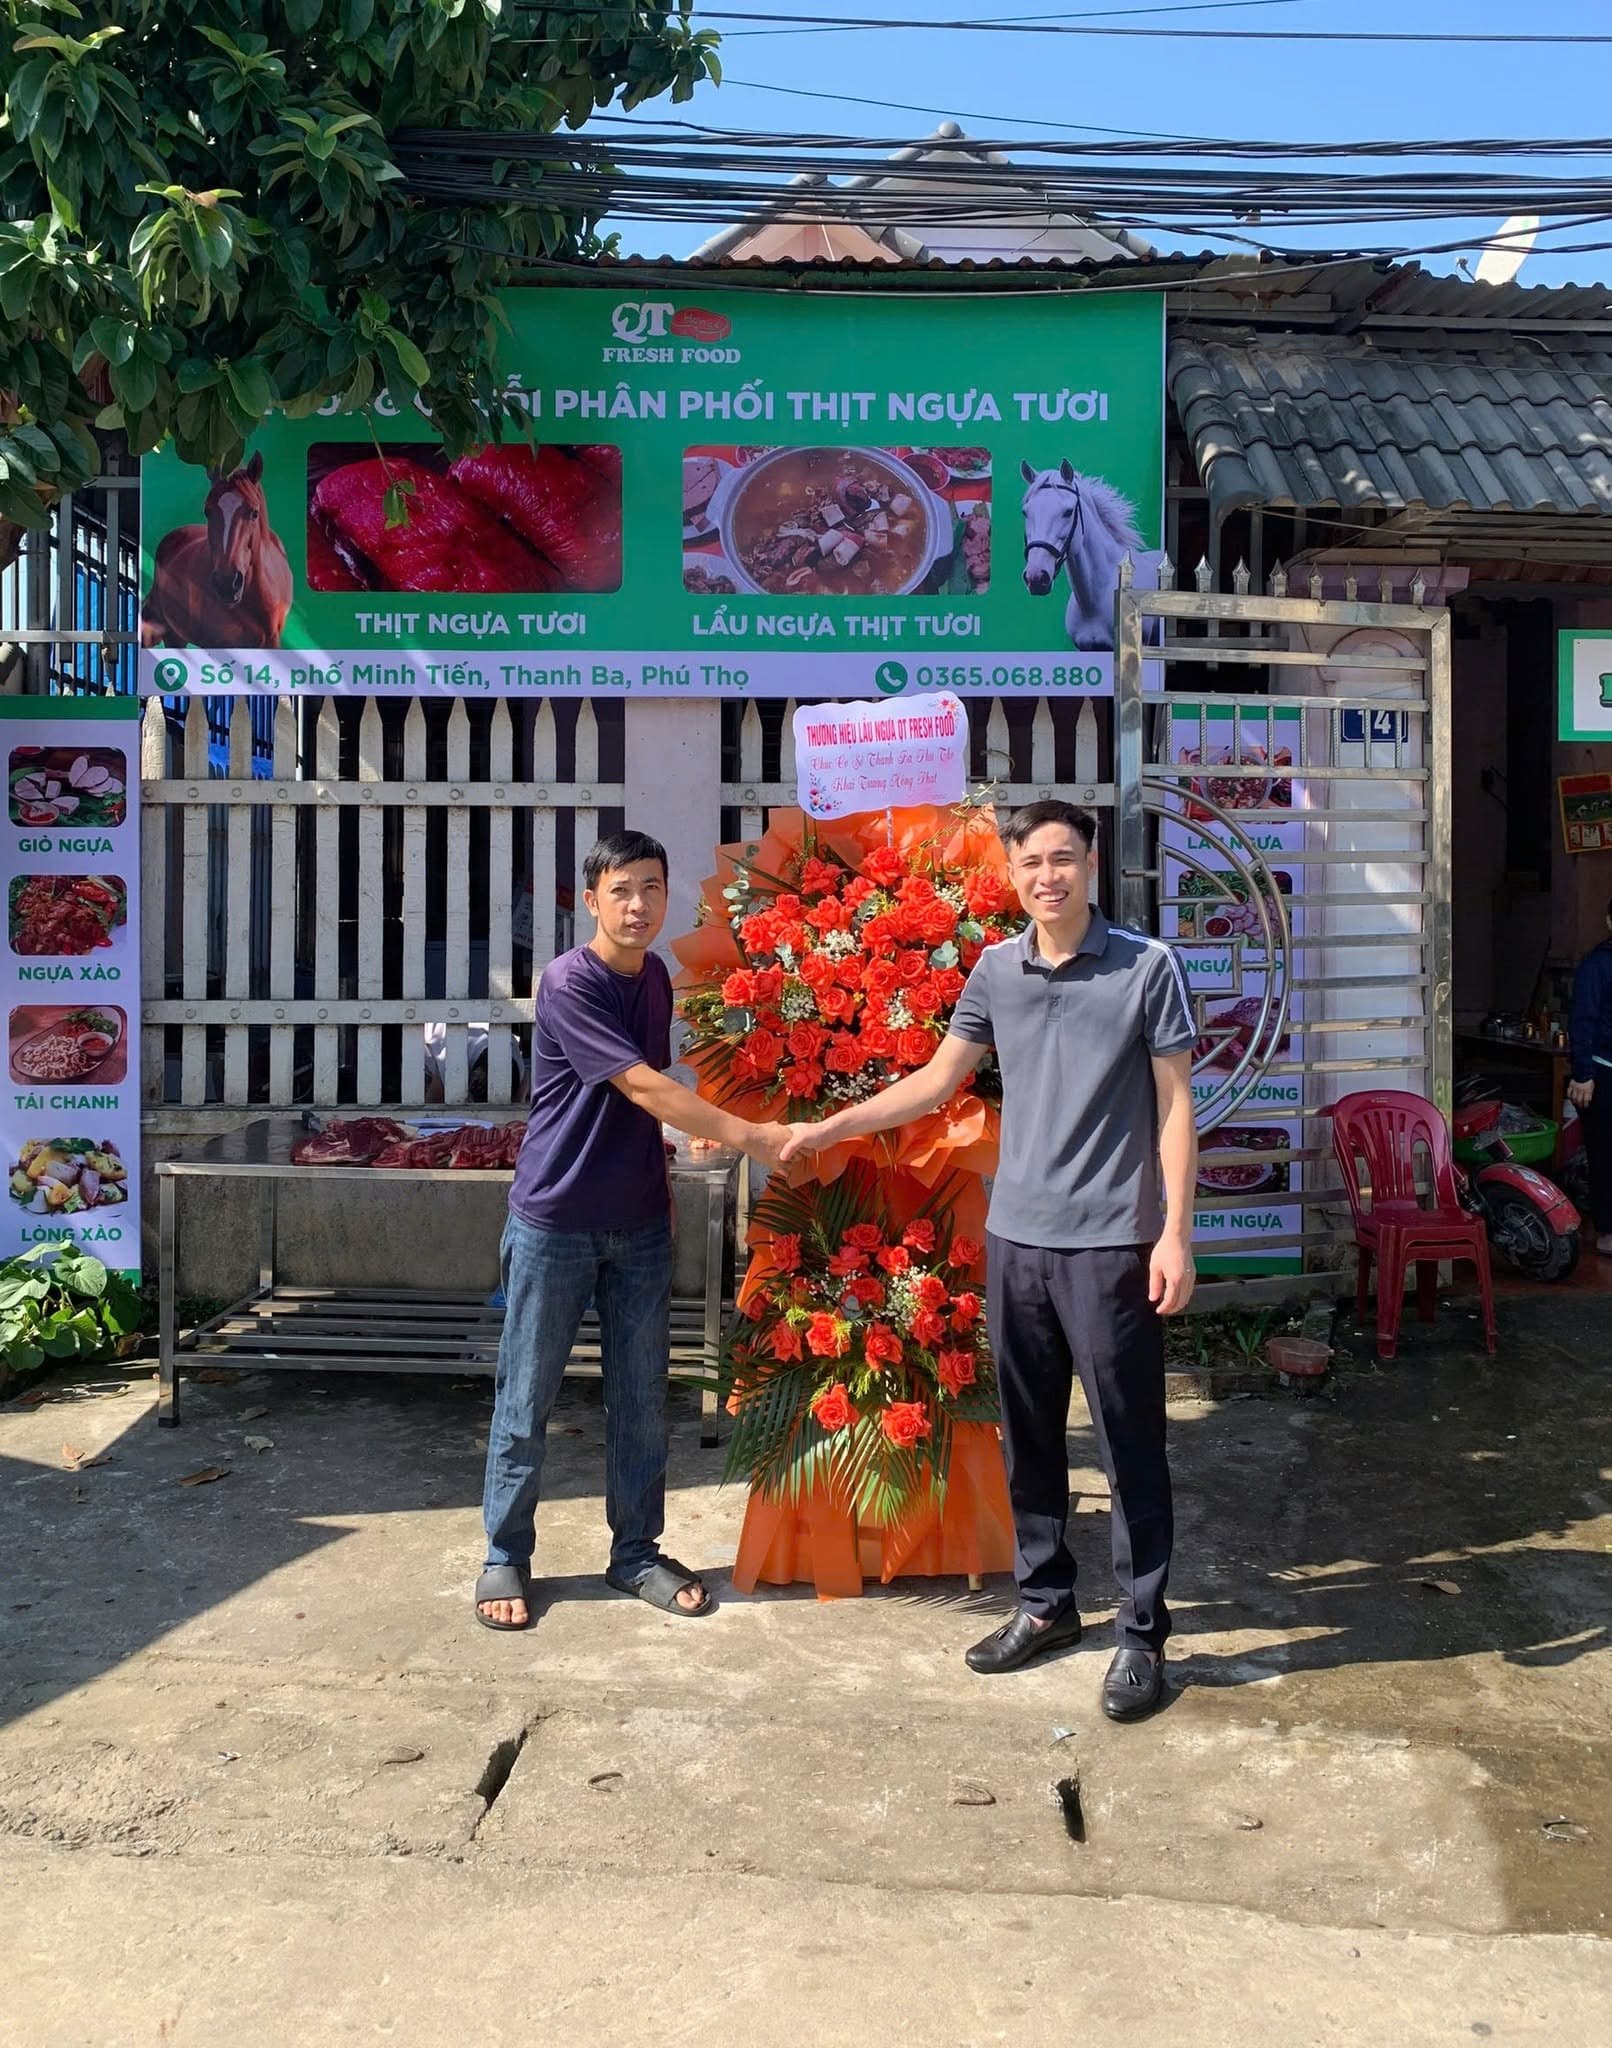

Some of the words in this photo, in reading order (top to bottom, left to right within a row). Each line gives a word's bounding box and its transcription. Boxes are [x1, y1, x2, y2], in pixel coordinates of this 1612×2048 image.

[611, 302, 675, 344] QT
[602, 347, 674, 363] FRESH
[681, 348, 741, 364] FOOD
[555, 381, 666, 418] PHÂN
[679, 378, 775, 420] PHỐI
[786, 391, 876, 428] THỊT
[887, 388, 1002, 429] NGỰA
[1013, 388, 1108, 421] TƯƠI
[355, 612, 420, 639] THỊT
[428, 612, 510, 640] NGỰA
[518, 612, 586, 635] TƯƠI
[692, 604, 748, 636] LẨU
[757, 612, 836, 641] NGỰA
[844, 615, 906, 641] THỊT
[914, 612, 981, 636] TƯƠI
[200, 659, 236, 685] Số
[243, 664, 280, 689] 14,
[290, 659, 344, 687] phố
[352, 664, 416, 685] Minh
[425, 660, 490, 689] Tiến,
[500, 664, 581, 686] Thanh
[591, 665, 632, 689] Ba,
[641, 664, 690, 686] Phú
[700, 665, 749, 691] Thọ
[916, 666, 1102, 687] 0365.068.880
[909, 716, 934, 740] FRESH
[935, 711, 955, 737] FOOD
[18, 834, 53, 852] GIÒ
[59, 837, 114, 856] NGỰA
[18, 965, 74, 984] NGỰA
[80, 963, 121, 980] XÀO
[50, 1095, 119, 1109] CHANH
[1231, 1212, 1283, 1231] NGỰA
[21, 1224, 75, 1242] LÒNG
[81, 1224, 122, 1241] XÀO
